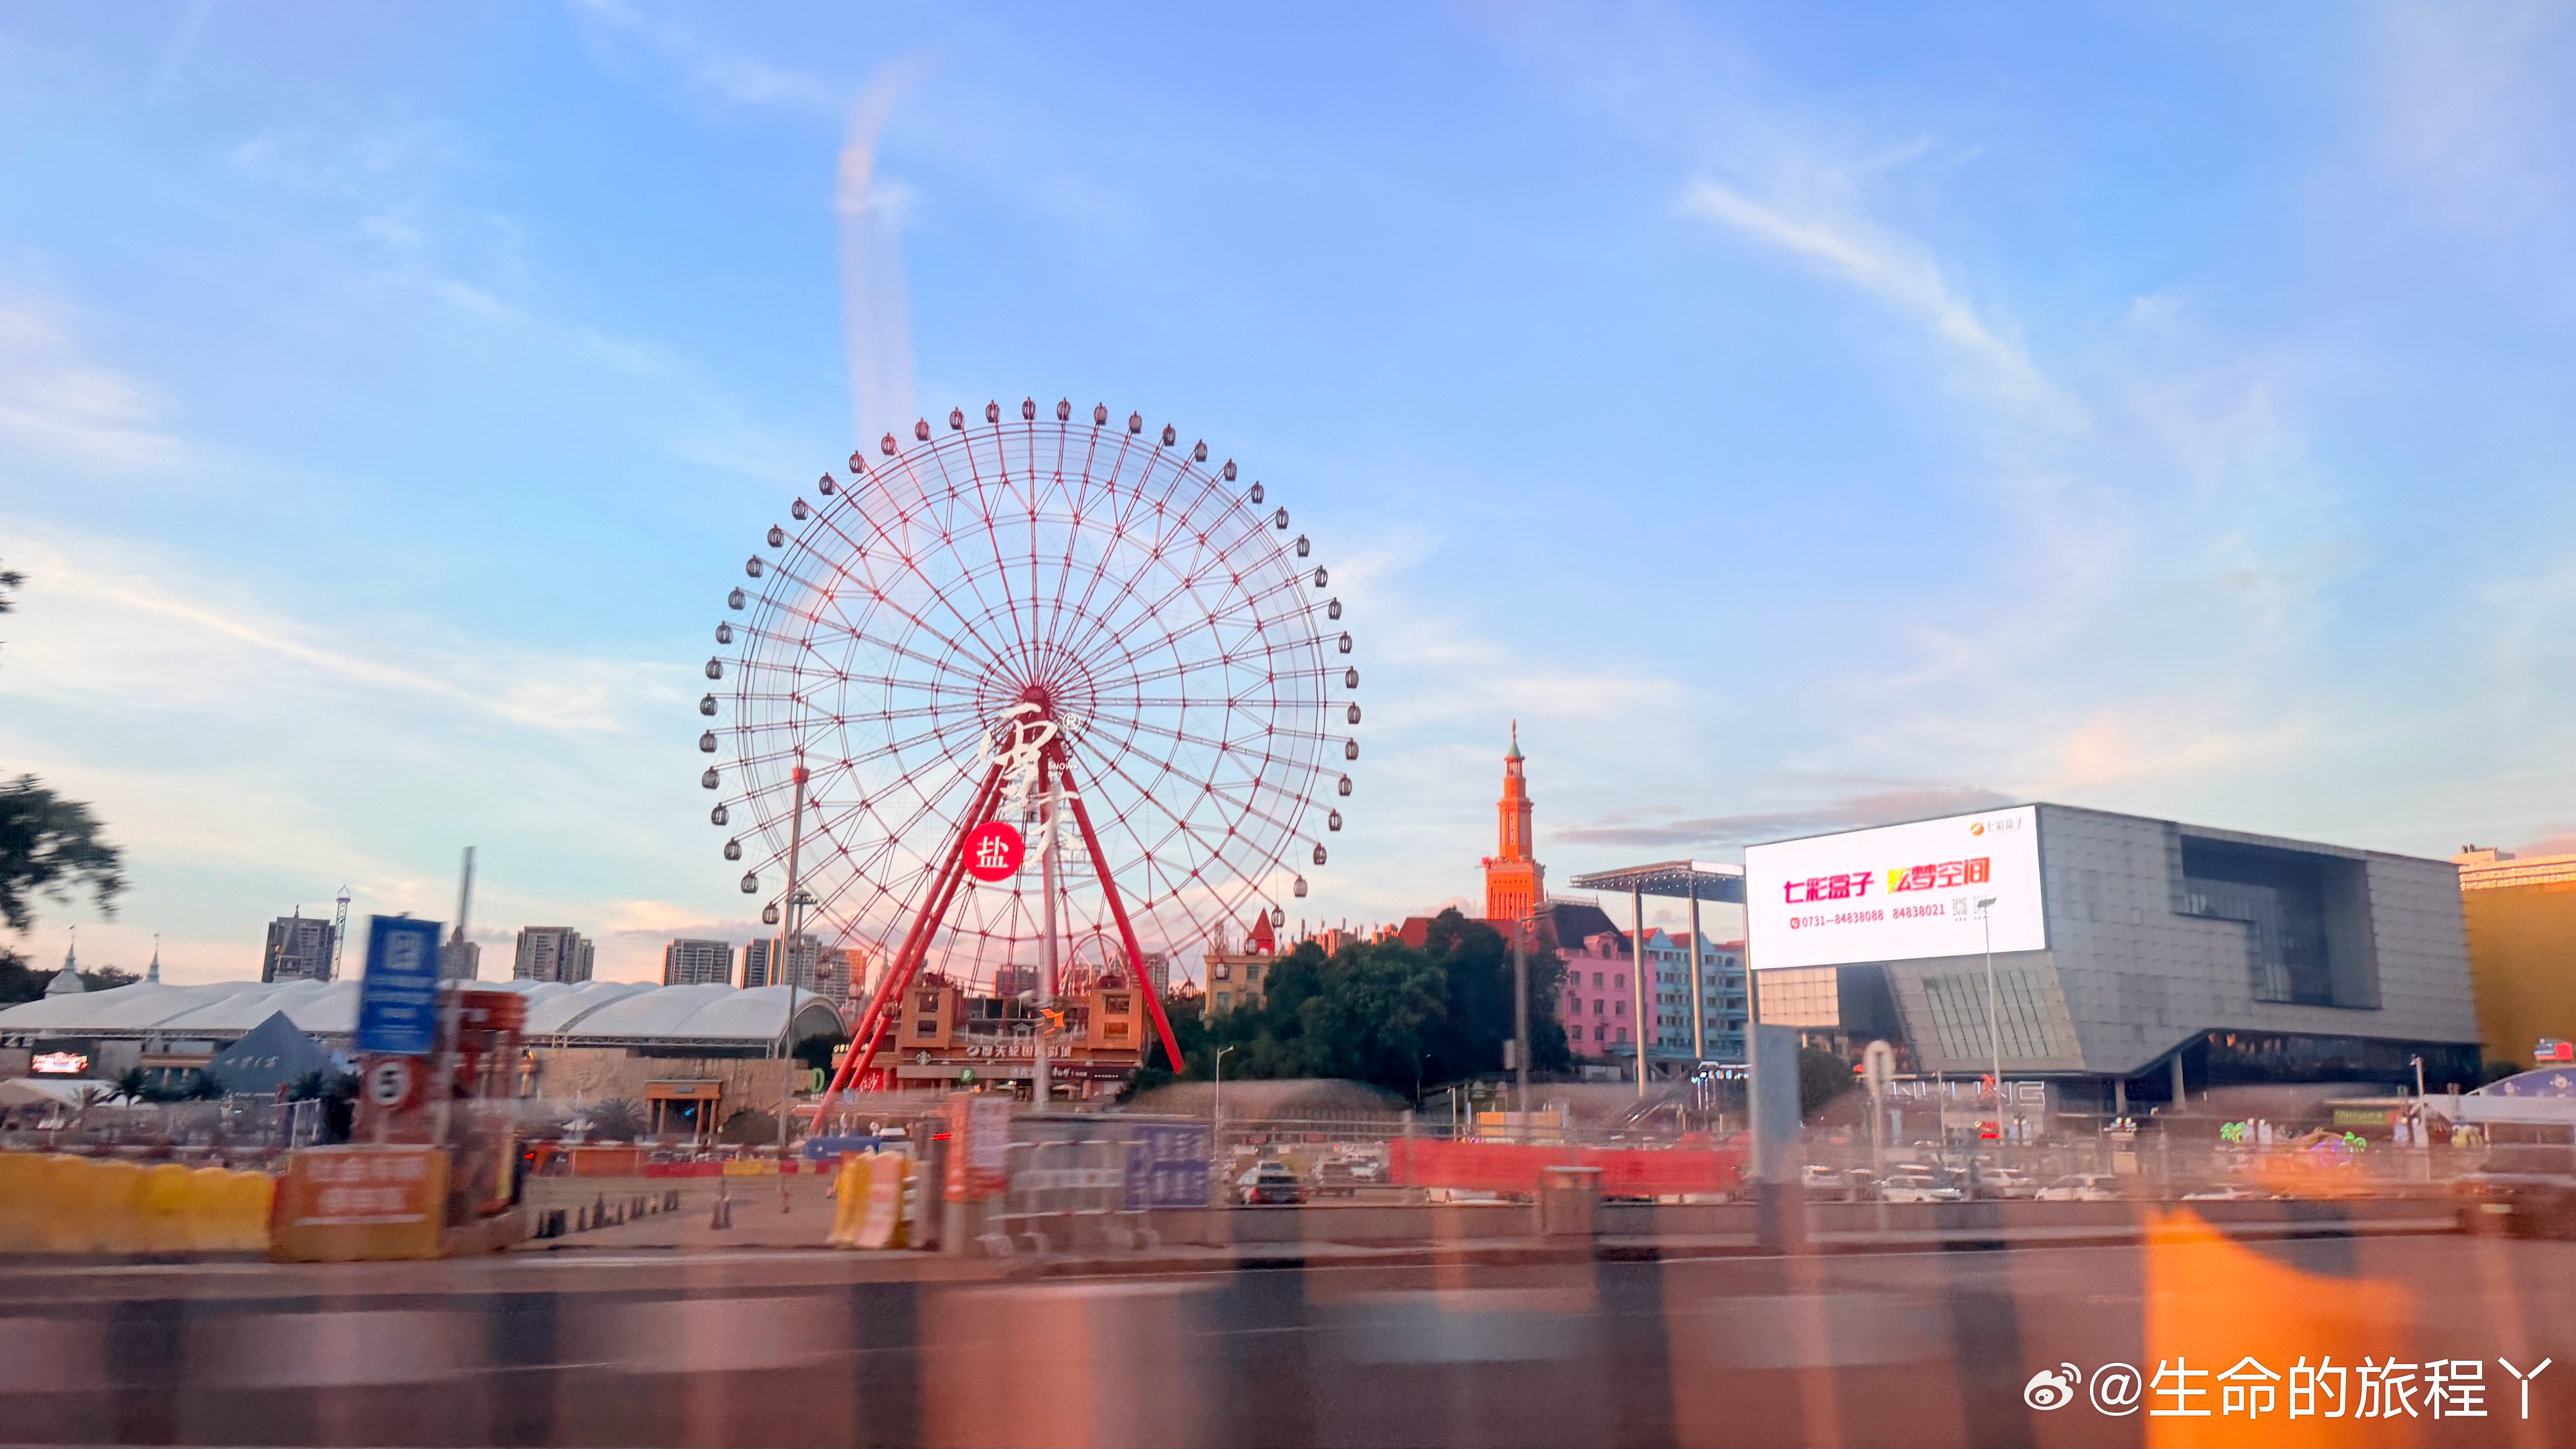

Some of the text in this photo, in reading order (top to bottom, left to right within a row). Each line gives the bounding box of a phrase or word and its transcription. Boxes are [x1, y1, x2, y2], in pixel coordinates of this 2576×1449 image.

[976, 836, 1009, 868] 盐
[1783, 856, 1990, 904] 七彩盒子 炫梦空间
[1893, 904, 1945, 919] 84838021
